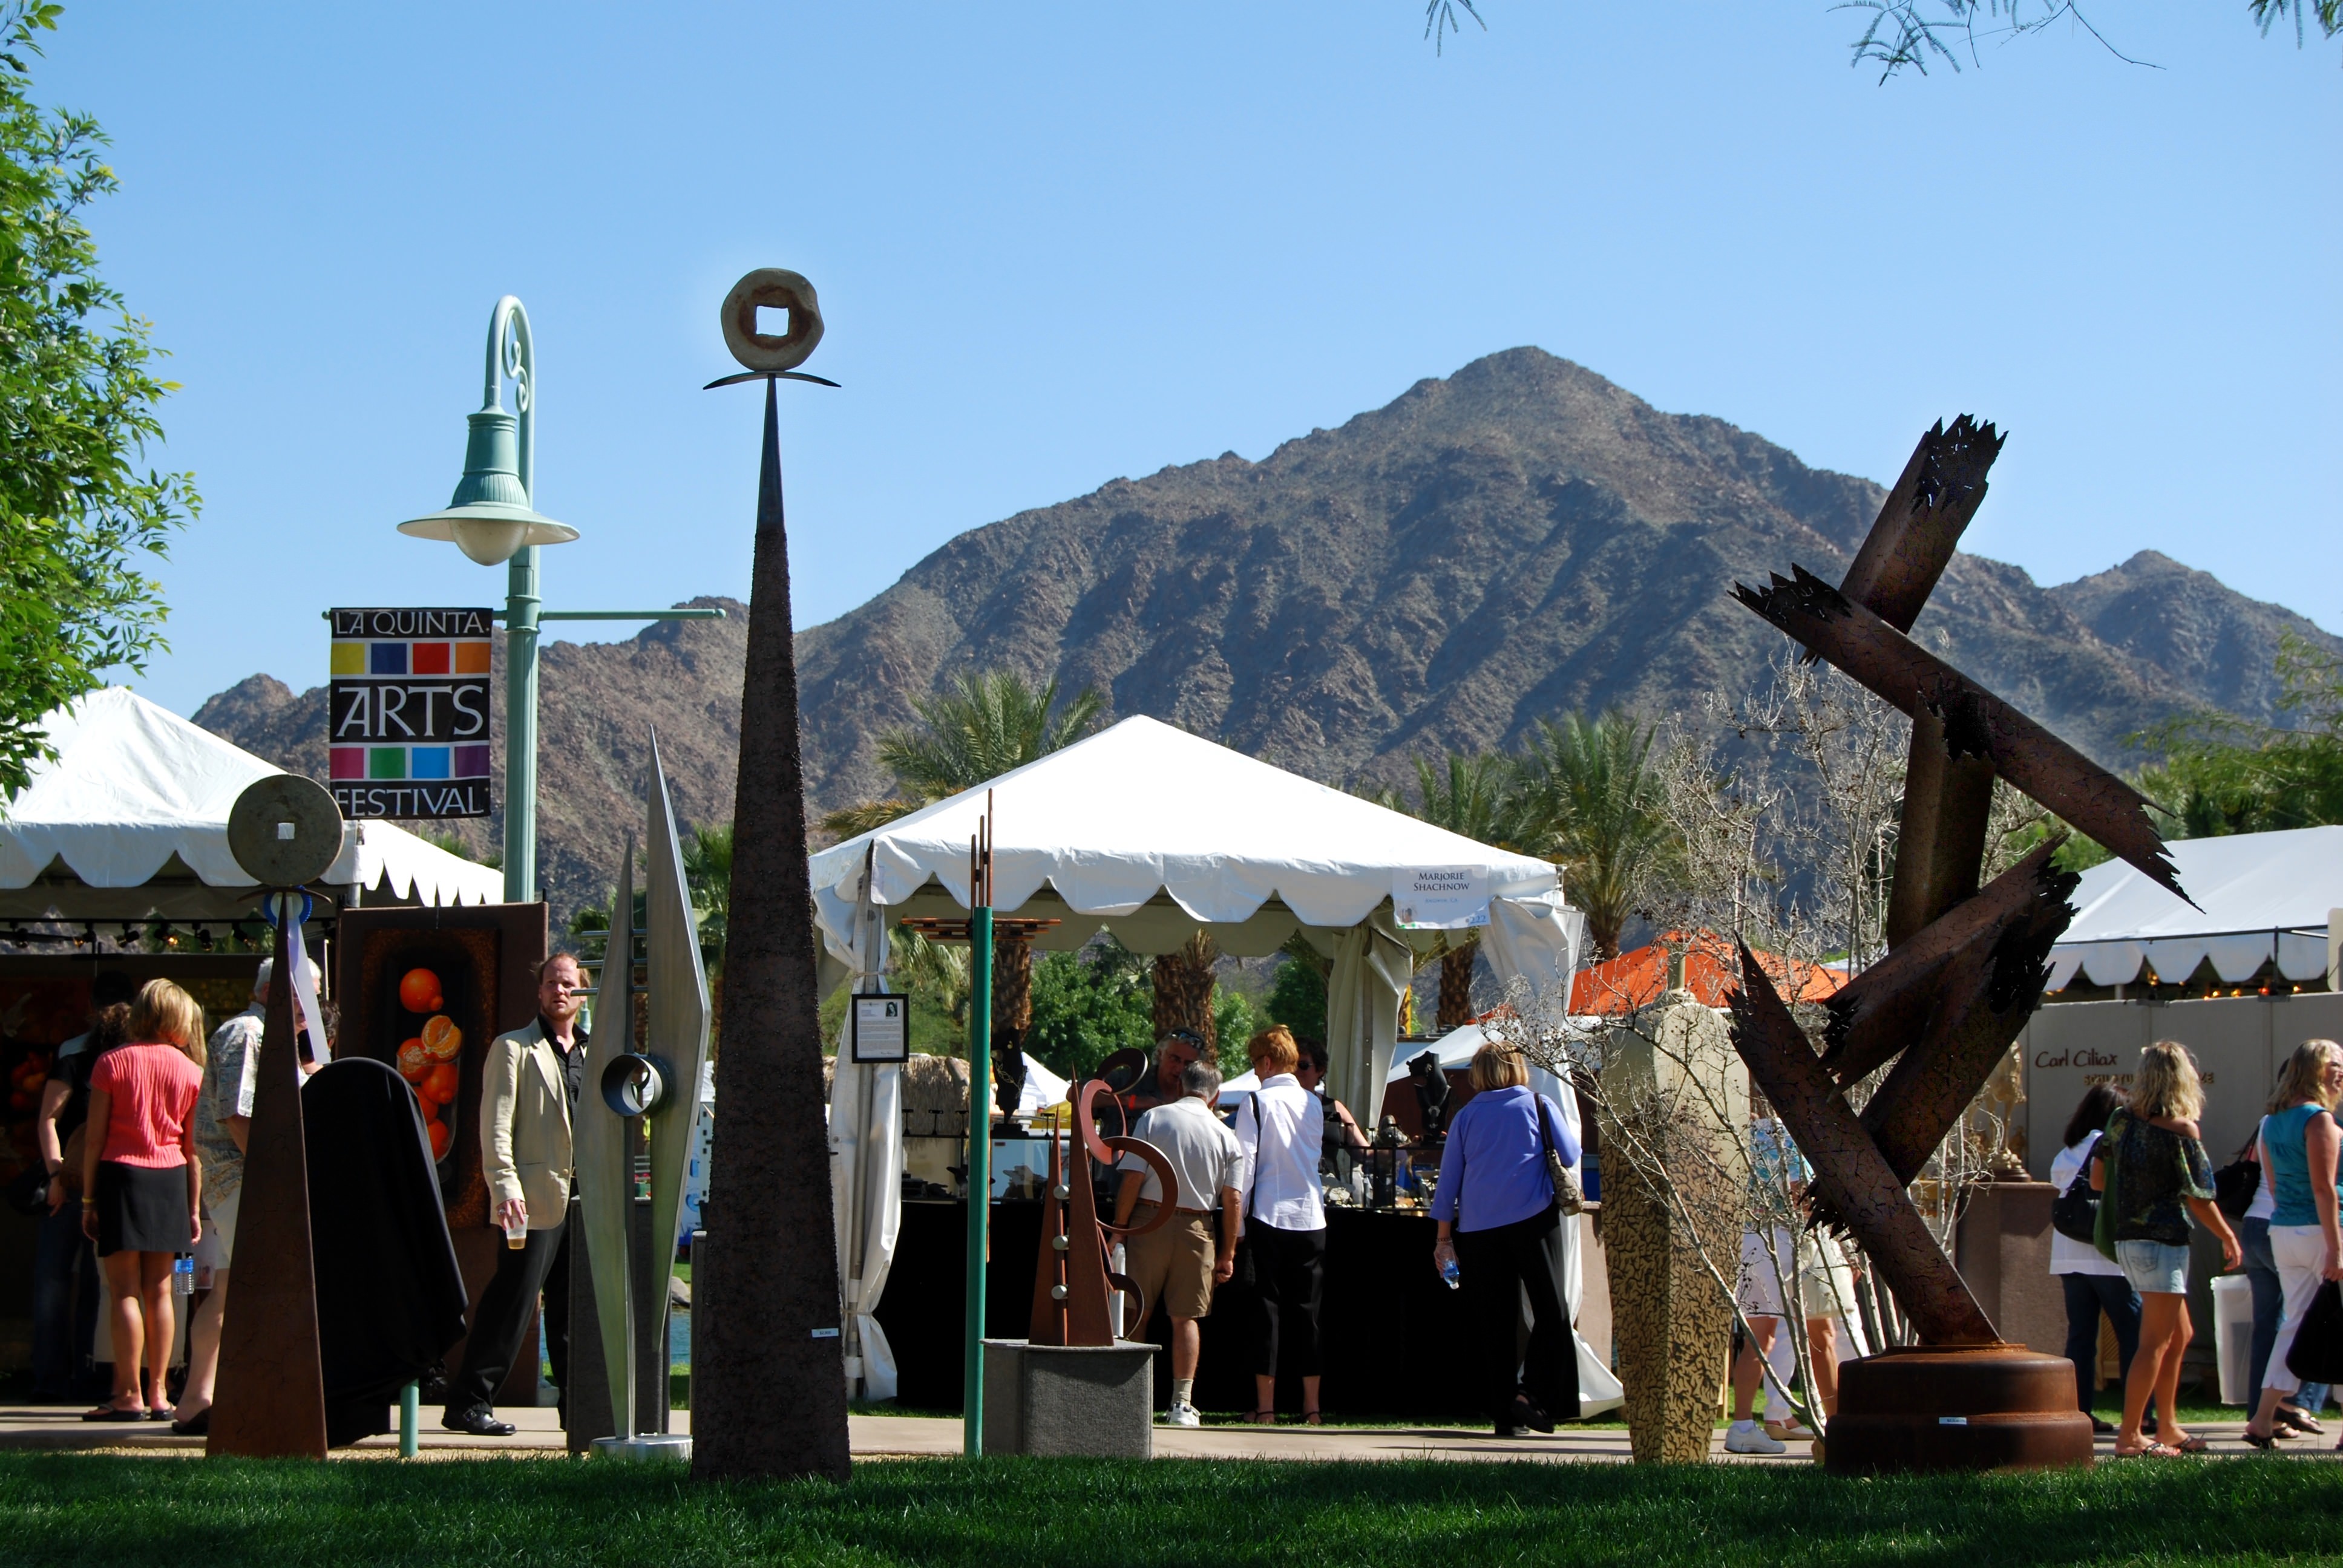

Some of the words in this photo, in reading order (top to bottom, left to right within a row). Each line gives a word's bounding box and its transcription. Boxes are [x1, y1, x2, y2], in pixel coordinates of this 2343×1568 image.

[335, 612, 364, 634] LA
[373, 611, 483, 635] QUINTA
[336, 684, 483, 737] ARTS
[335, 786, 484, 817] FESTIVAL
[1414, 883, 1470, 891] SHACHNOW
[1418, 872, 1464, 881] MARJORIE
[2034, 1048, 2068, 1068] Carl
[2073, 1048, 2118, 1067] Ciliax
